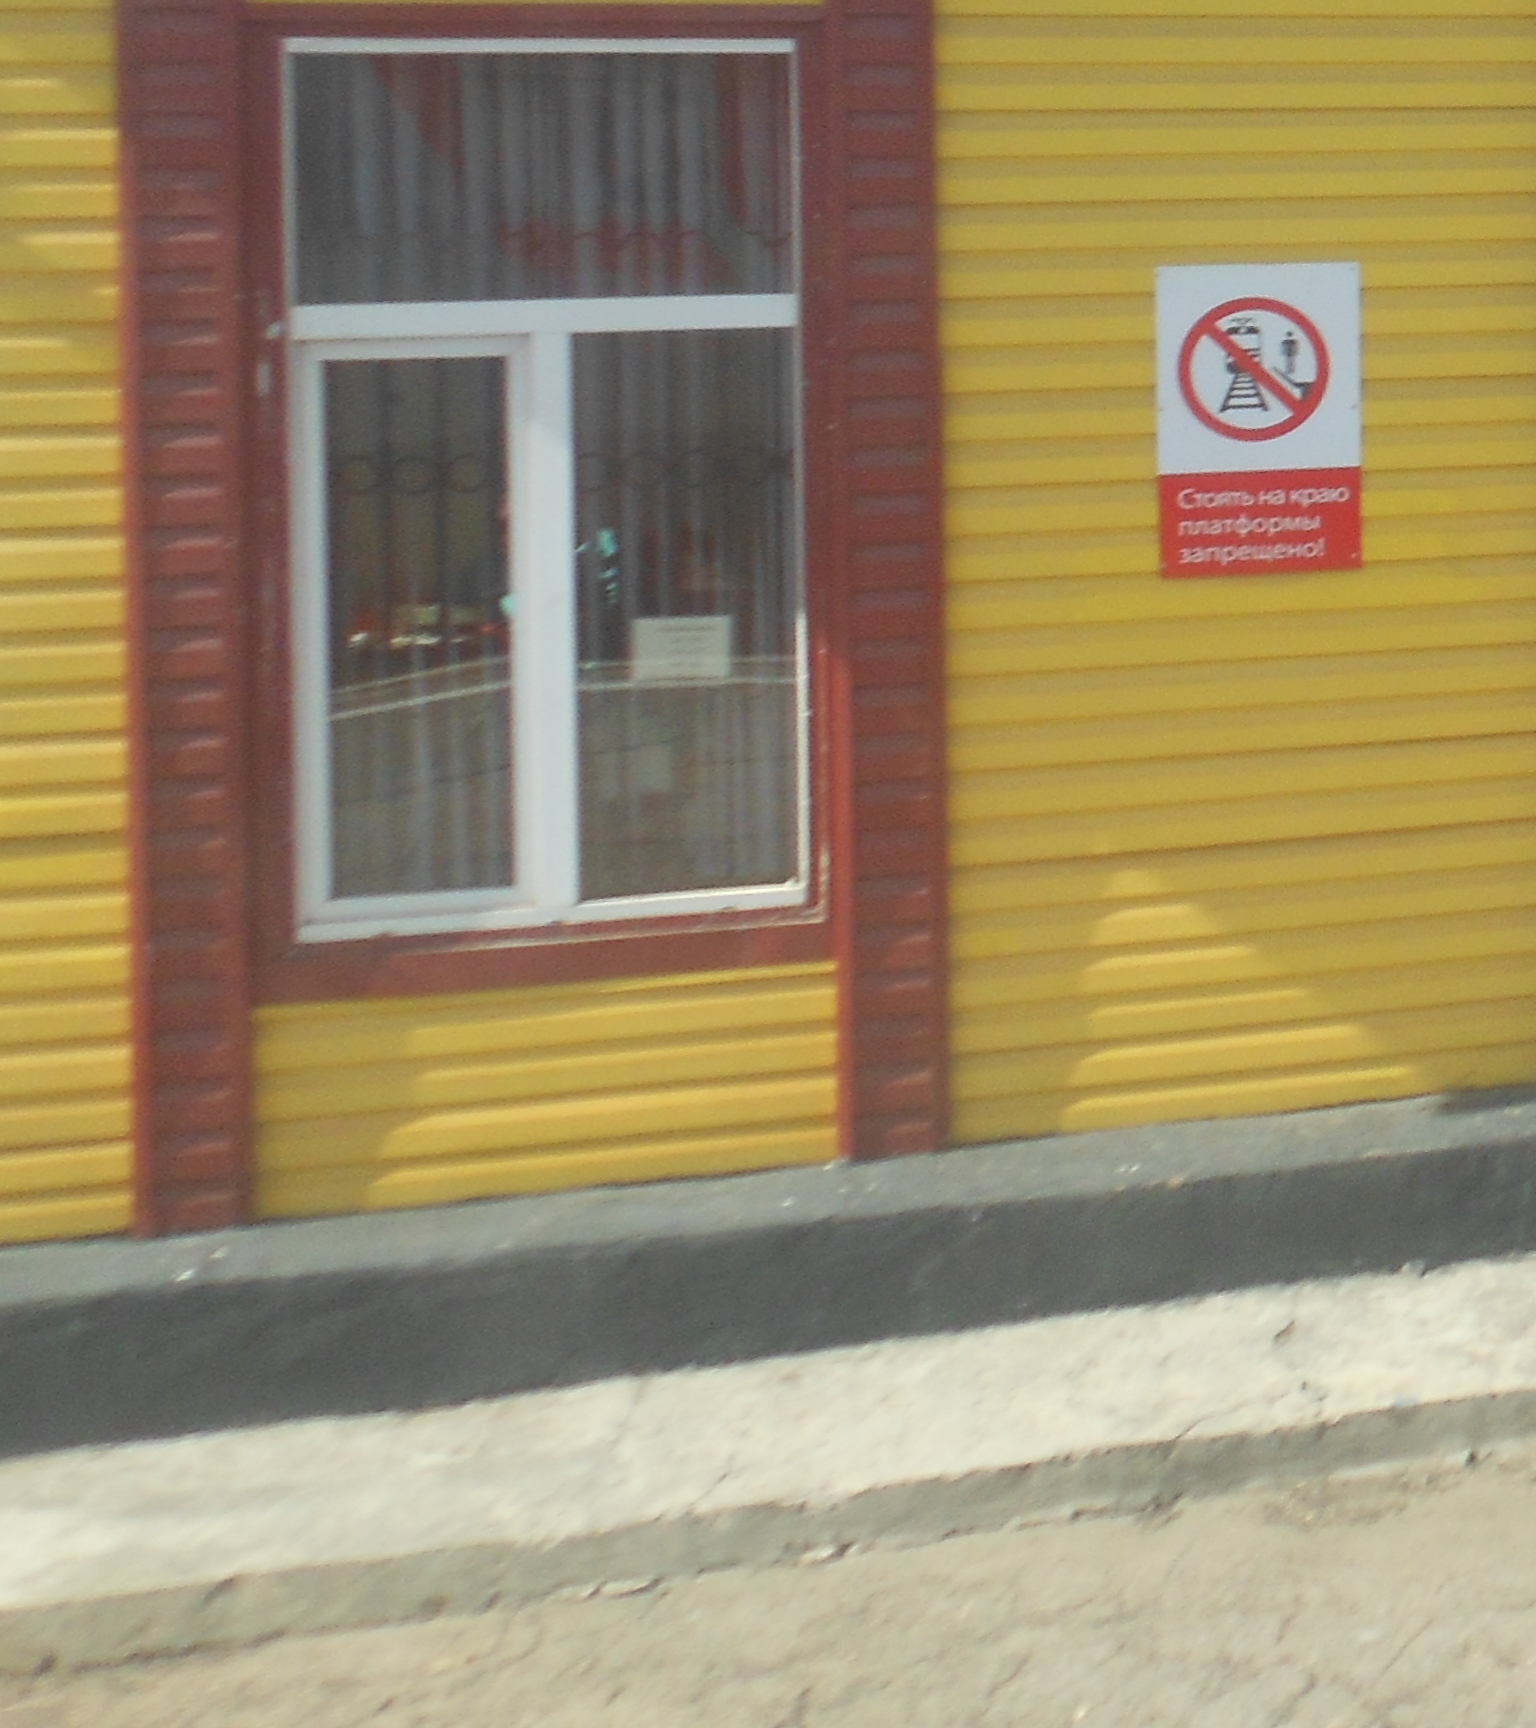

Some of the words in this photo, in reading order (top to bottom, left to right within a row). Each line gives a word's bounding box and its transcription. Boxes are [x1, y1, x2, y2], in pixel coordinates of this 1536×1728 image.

[1177, 488, 1255, 509] Стоять
[1258, 489, 1286, 505] на
[1290, 487, 1349, 508] краю
[1177, 513, 1322, 538] платформы
[1178, 537, 1327, 566] запрещено!
